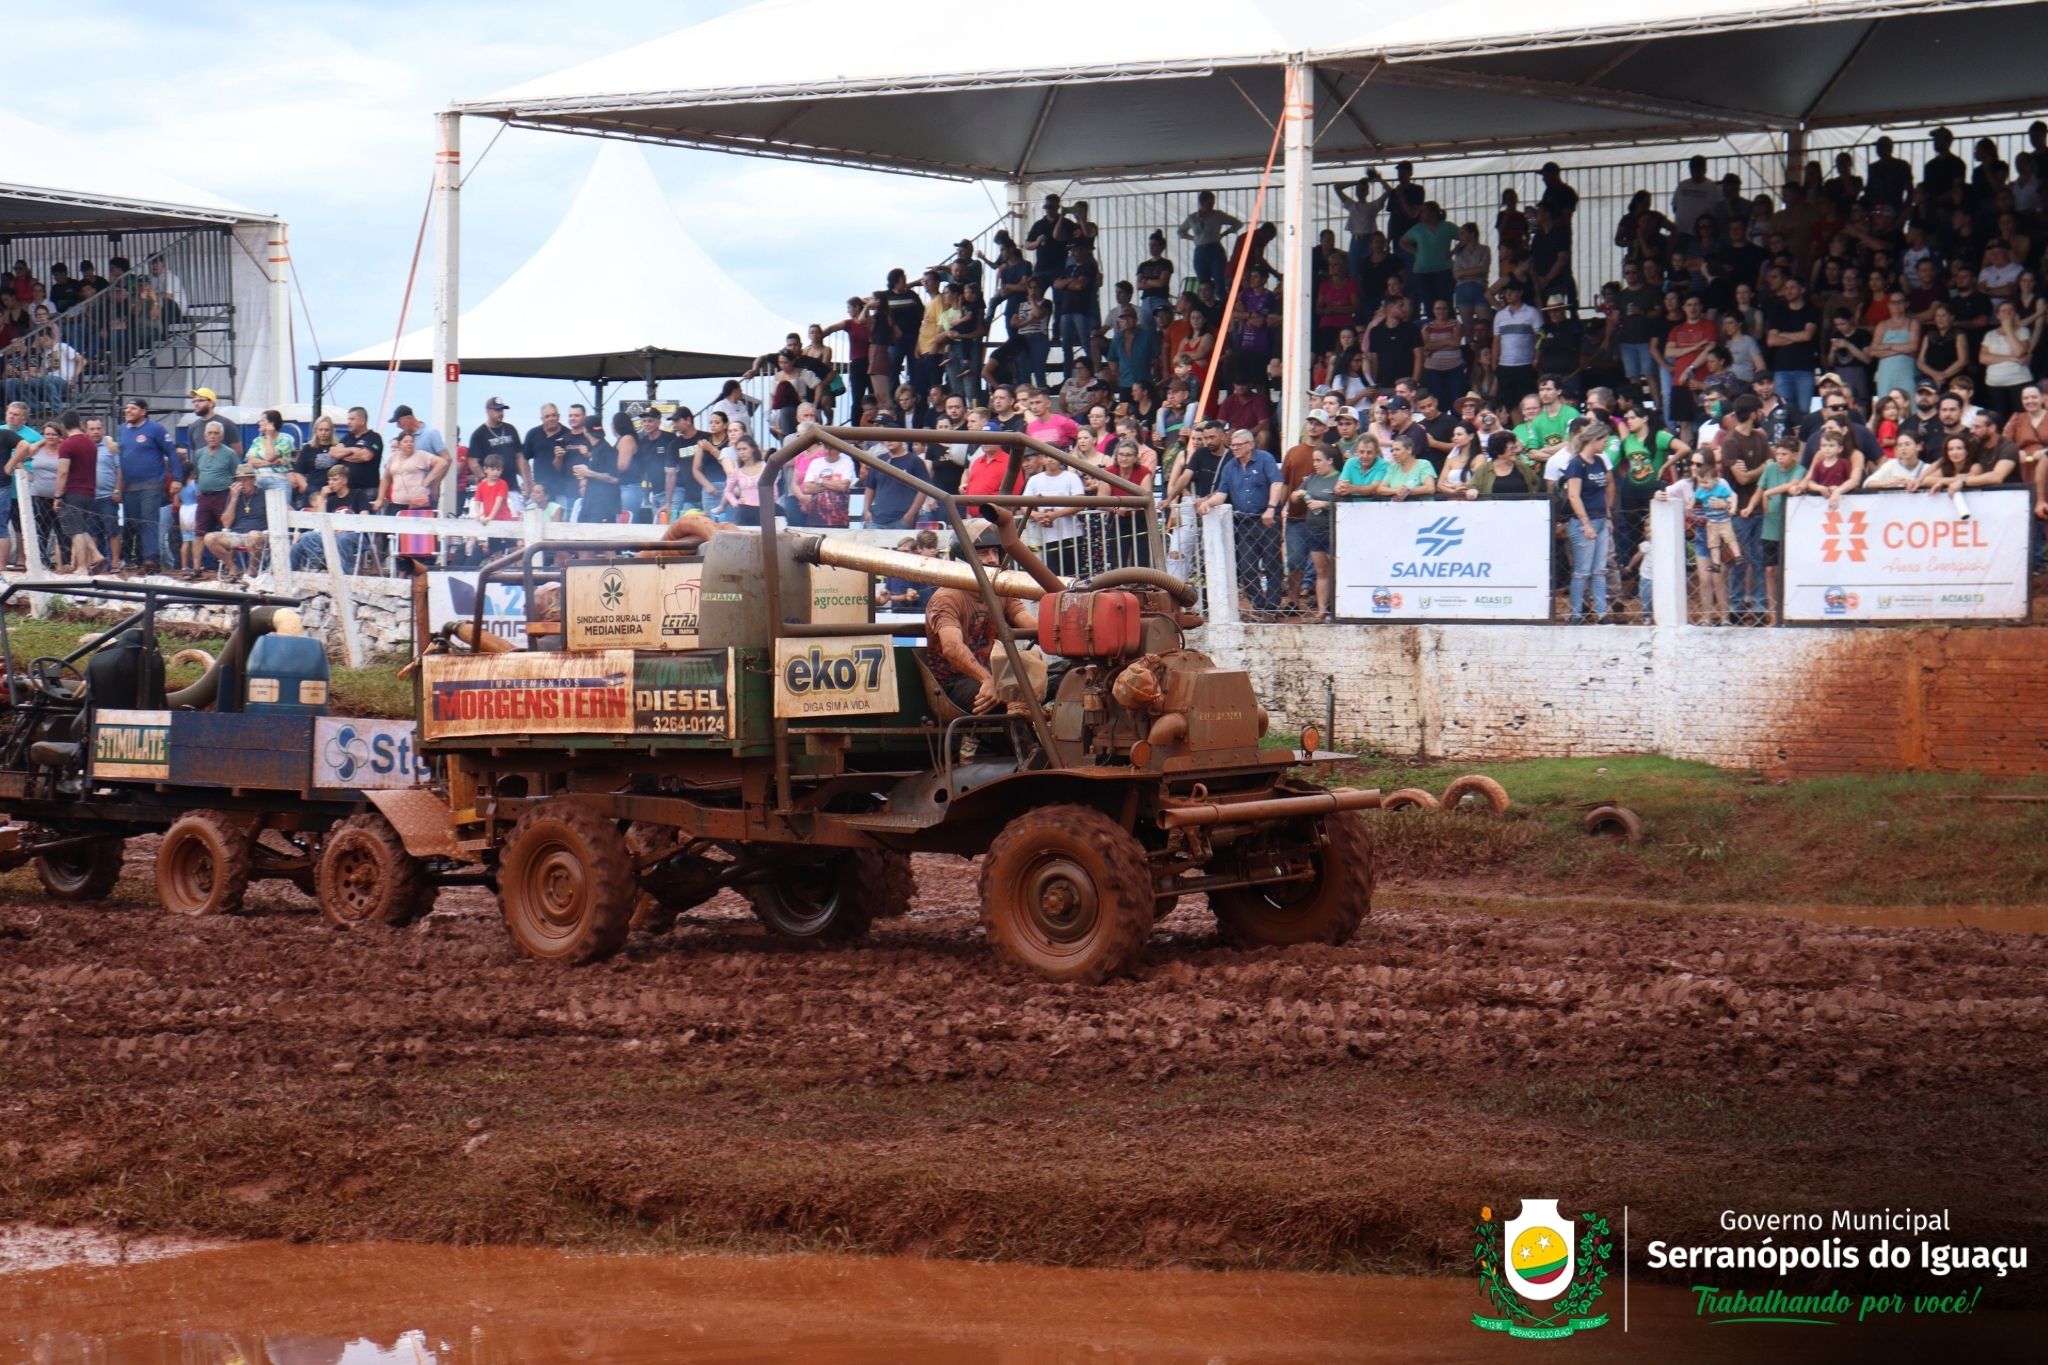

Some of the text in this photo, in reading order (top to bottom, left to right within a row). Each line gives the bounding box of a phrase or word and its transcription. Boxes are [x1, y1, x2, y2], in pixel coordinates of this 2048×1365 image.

[1882, 520, 1989, 549] COPEL
[1390, 561, 1493, 579] SANEPAR
[813, 594, 869, 609] agroceres
[1474, 596, 1502, 605] ACIASI
[576, 613, 652, 624] SINDICATO RURAL DE
[584, 624, 643, 636] MEDIANEIRA
[490, 678, 581, 689] IMPLEMENTOS
[438, 687, 627, 721] MORGENSTERN
[634, 689, 726, 711] DIESEL
[803, 702, 824, 713] DIGA
[826, 701, 841, 711] SIM
[851, 700, 870, 710] VIDA
[653, 716, 725, 733] 3264-0124
[97, 727, 167, 761] STIMULATE
